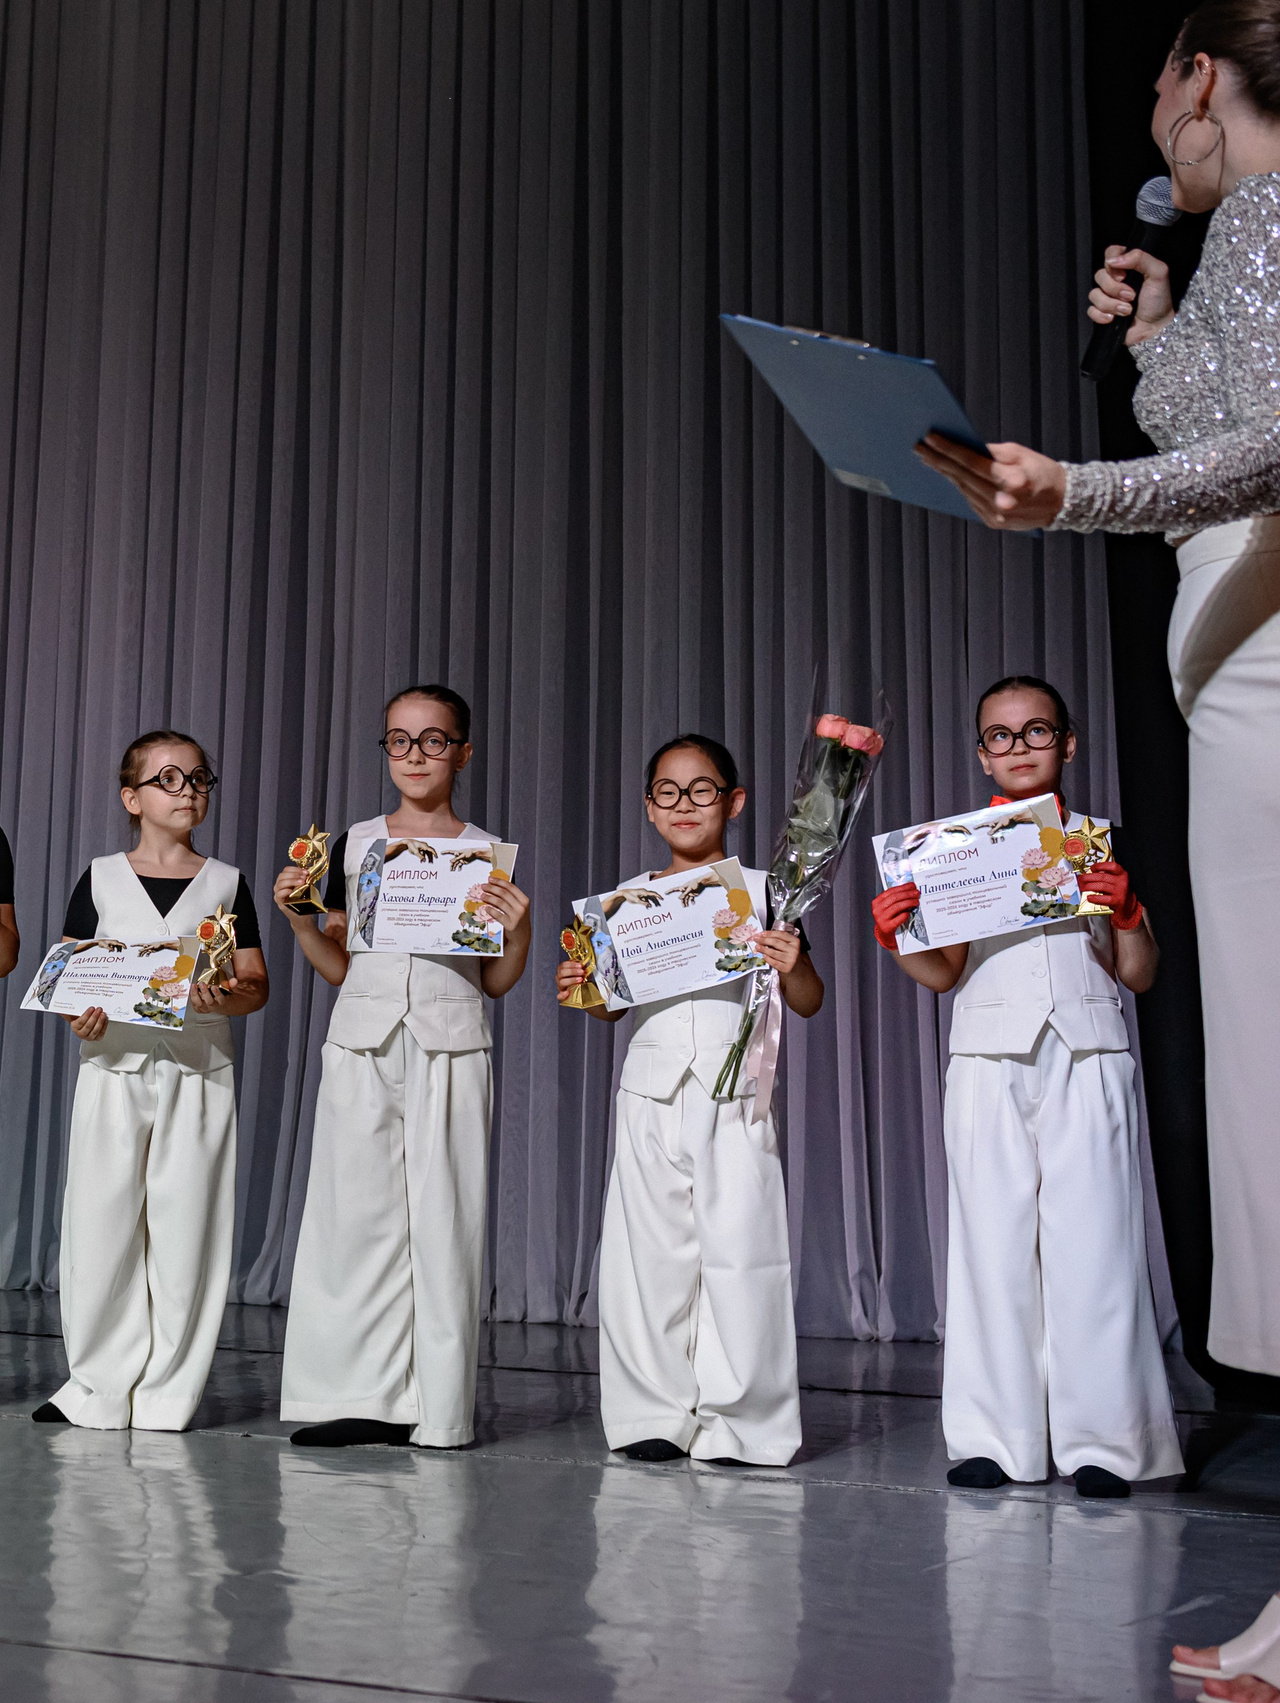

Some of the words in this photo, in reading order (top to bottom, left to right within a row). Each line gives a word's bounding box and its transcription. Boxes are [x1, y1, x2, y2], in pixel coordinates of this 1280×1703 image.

[386, 869, 438, 881] ДИПЛОМ
[919, 875, 986, 895] Пантелеева
[988, 868, 1018, 881] Анна
[380, 892, 415, 903] Хахова
[418, 893, 457, 907] Варвара
[617, 912, 673, 937] ДИПЛОМ
[620, 946, 643, 958] Цой
[645, 929, 704, 951] Анастасия
[72, 956, 125, 965] ДИПЛОМ
